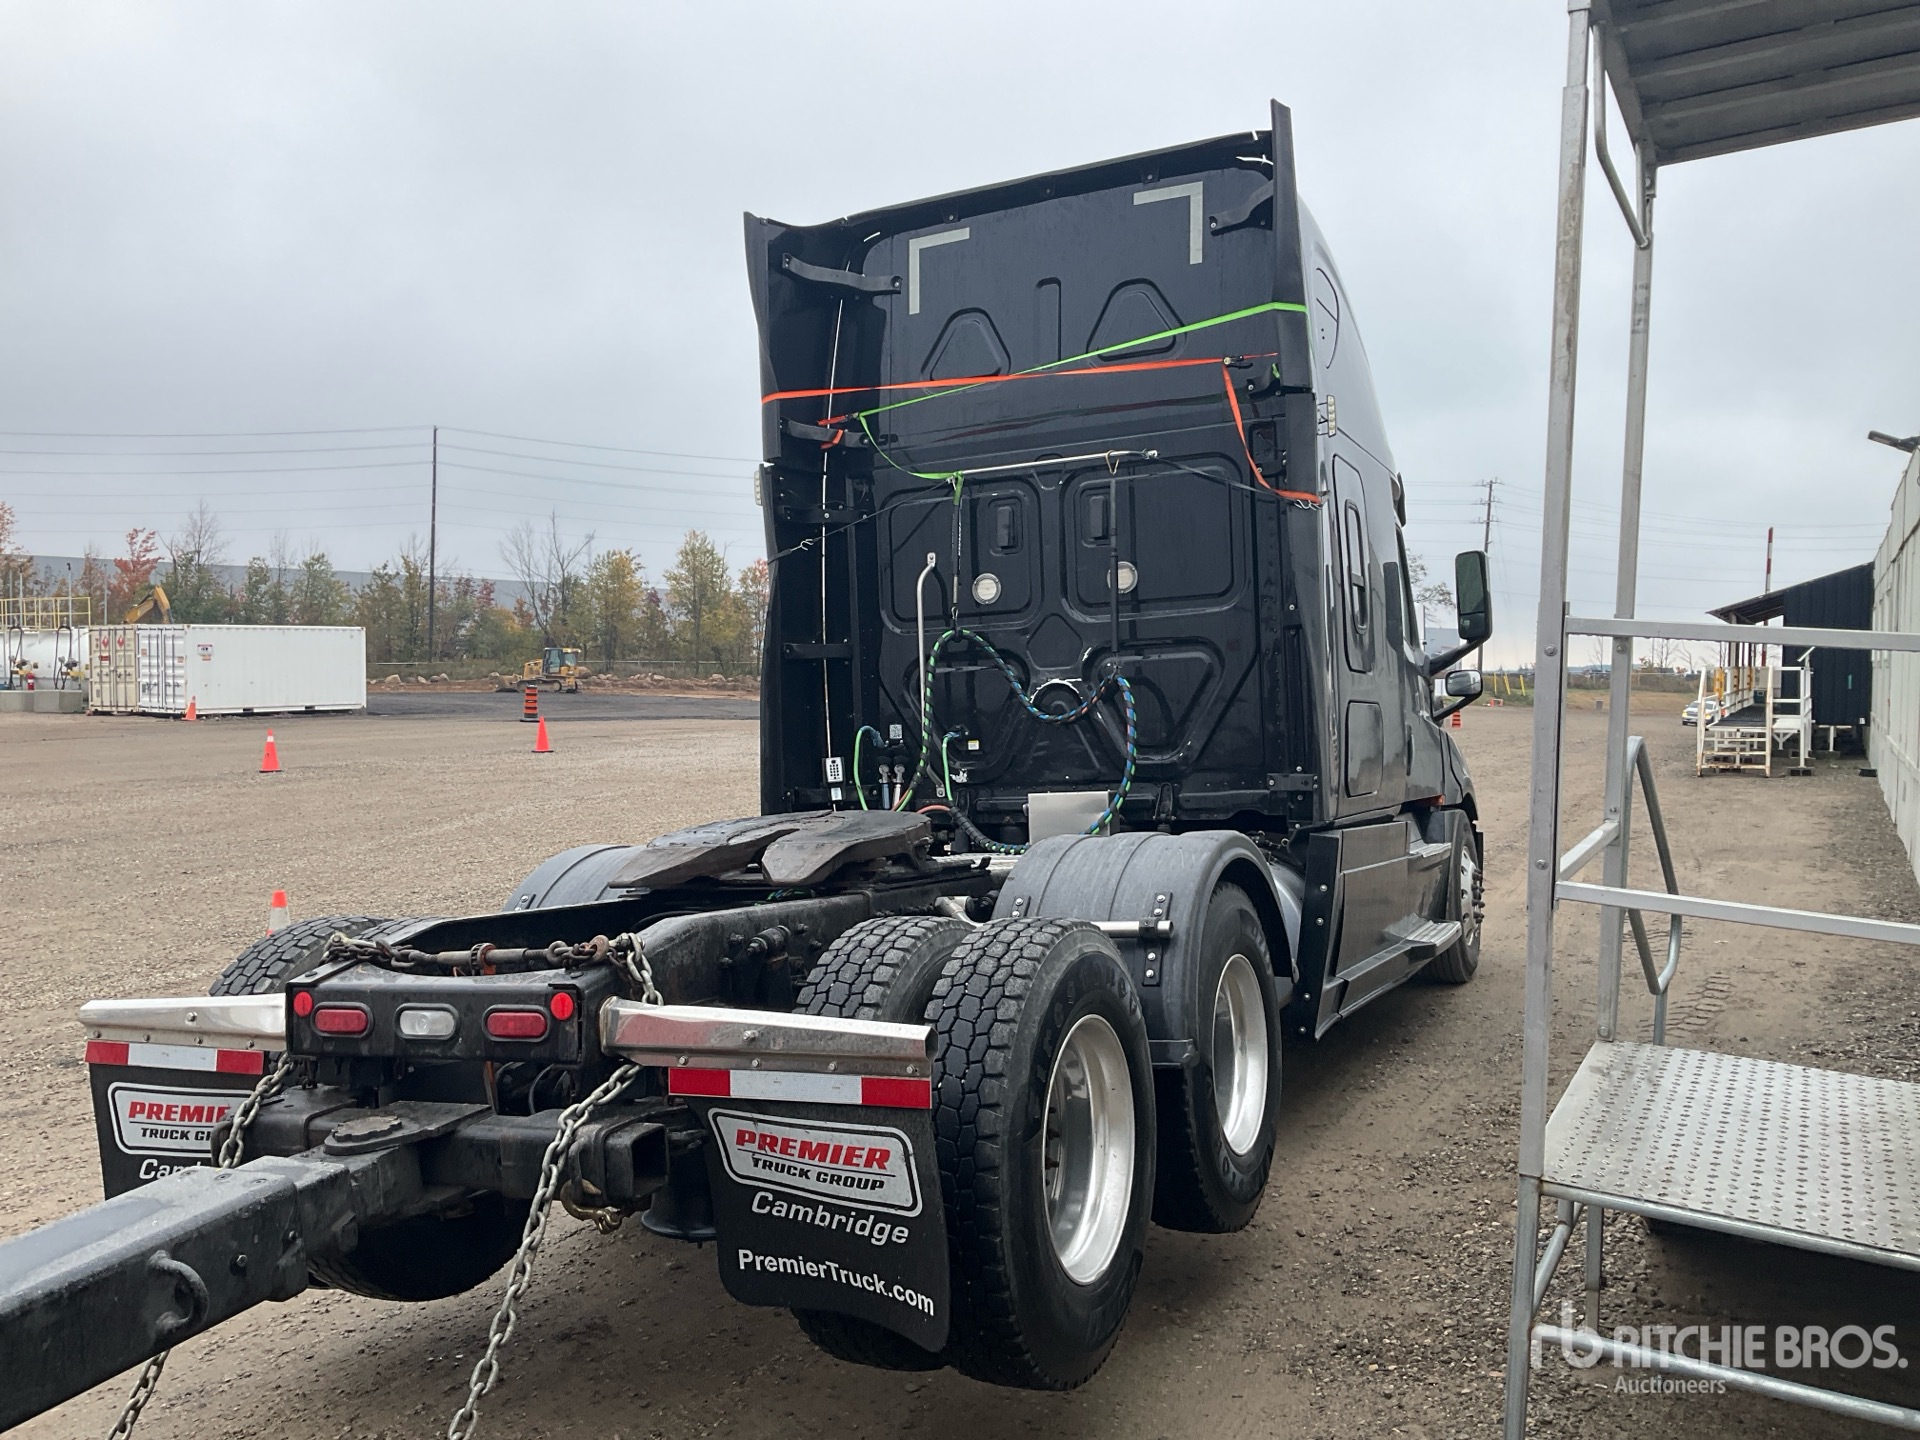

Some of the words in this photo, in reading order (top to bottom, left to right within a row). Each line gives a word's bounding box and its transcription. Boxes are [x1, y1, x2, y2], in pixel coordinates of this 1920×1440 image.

[128, 1101, 232, 1123] PREMIE
[141, 1127, 190, 1141] TRUCK
[735, 1129, 891, 1170] PREMIER
[752, 1155, 811, 1180] TRUCK
[815, 1170, 886, 1192] GROUP
[751, 1191, 909, 1246] Cambridge
[738, 1249, 935, 1316] PremierTruck.com
